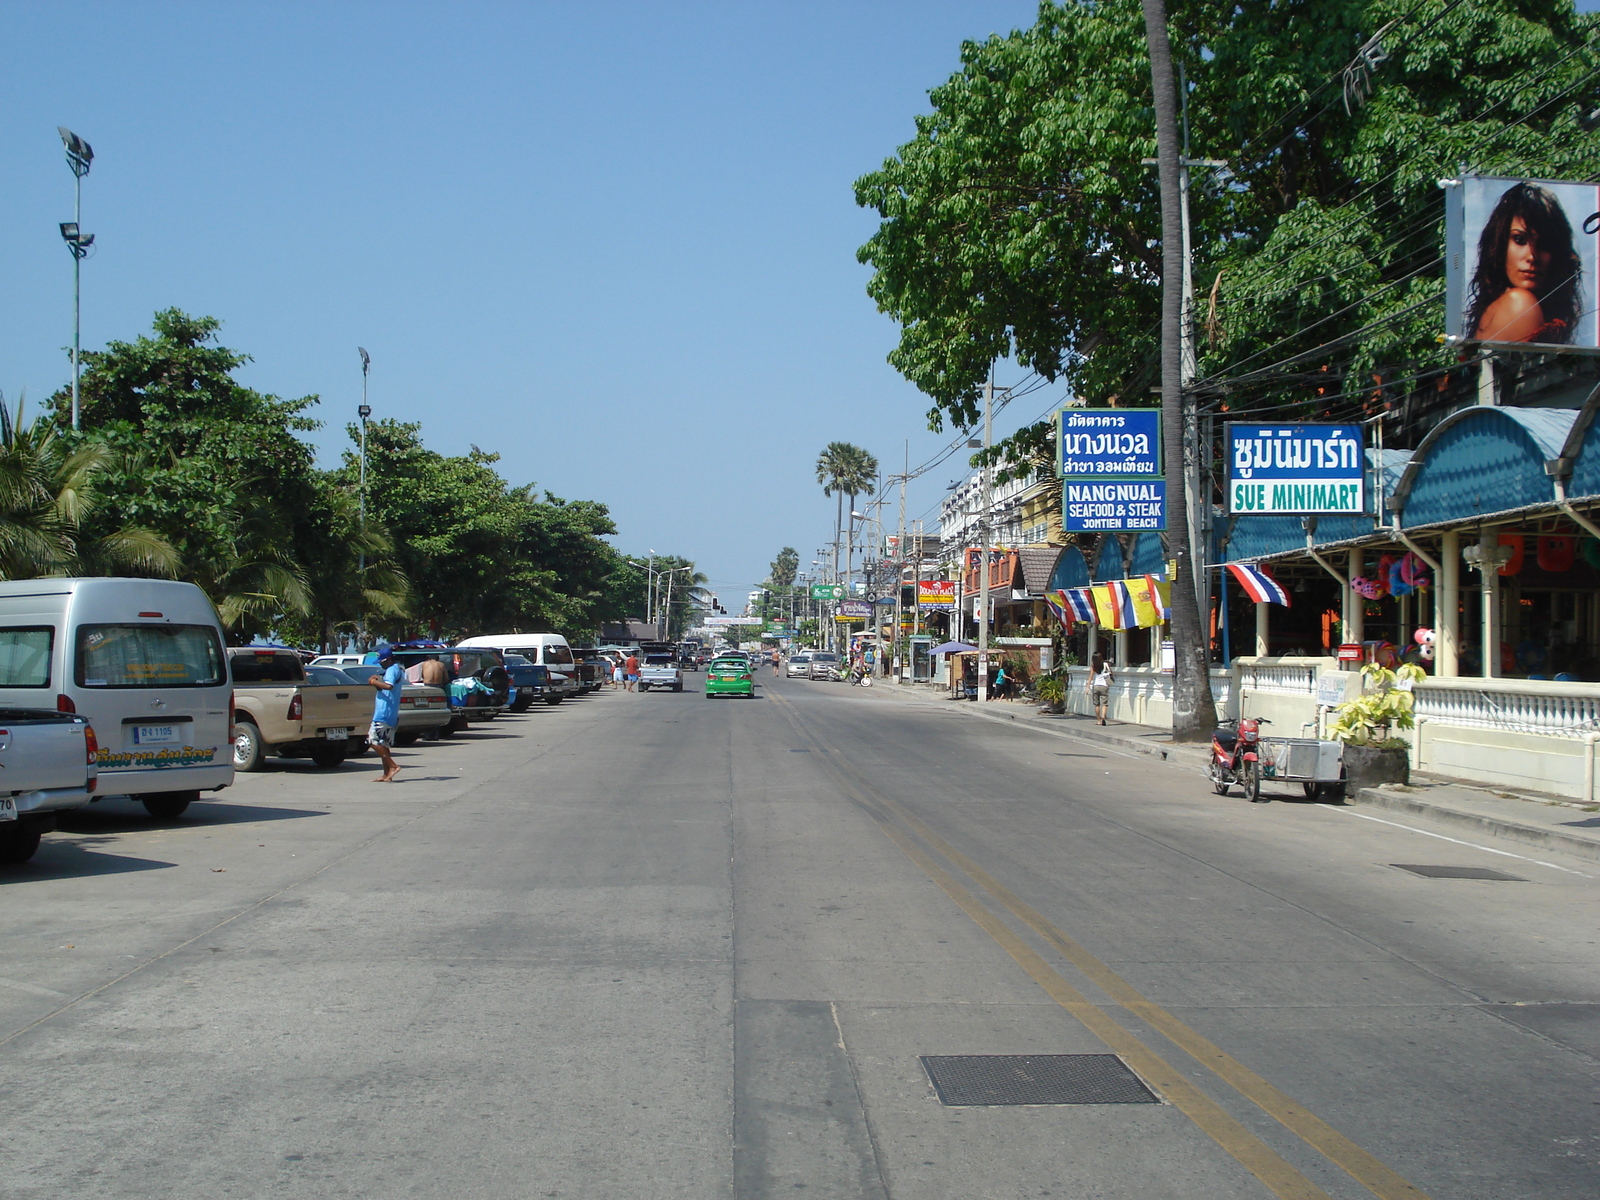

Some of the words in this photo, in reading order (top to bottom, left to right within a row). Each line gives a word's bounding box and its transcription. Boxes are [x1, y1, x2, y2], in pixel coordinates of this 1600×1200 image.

[1067, 413, 1126, 428] ภัตตาคาร
[1064, 433, 1150, 455] นางนวล
[1234, 430, 1358, 479] ซูมินิมาร์ท
[1068, 484, 1162, 502] NANGNUAL
[1235, 484, 1265, 511] SUE
[1271, 484, 1358, 510] MINIMART
[1069, 503, 1115, 517] SEAFOOD
[1116, 504, 1126, 517] &
[1128, 502, 1162, 516] STEAK
[1082, 518, 1122, 529] JOMTIEN
[1127, 518, 1157, 528] BEACH
[155, 726, 172, 736] 1105
